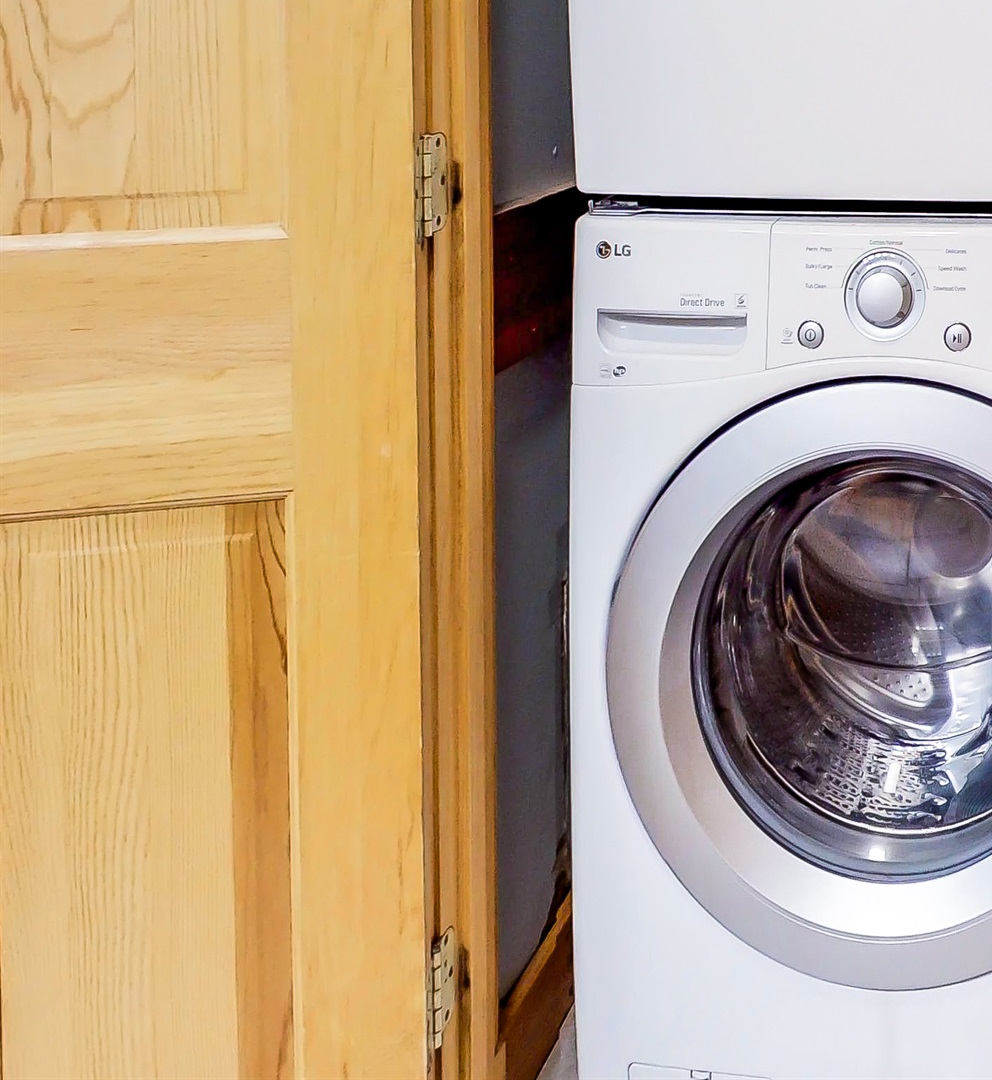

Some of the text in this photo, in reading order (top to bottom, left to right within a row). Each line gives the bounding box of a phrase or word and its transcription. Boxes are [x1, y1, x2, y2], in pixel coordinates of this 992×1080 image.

[614, 244, 632, 257] LG
[680, 297, 725, 307] Direct Drive
